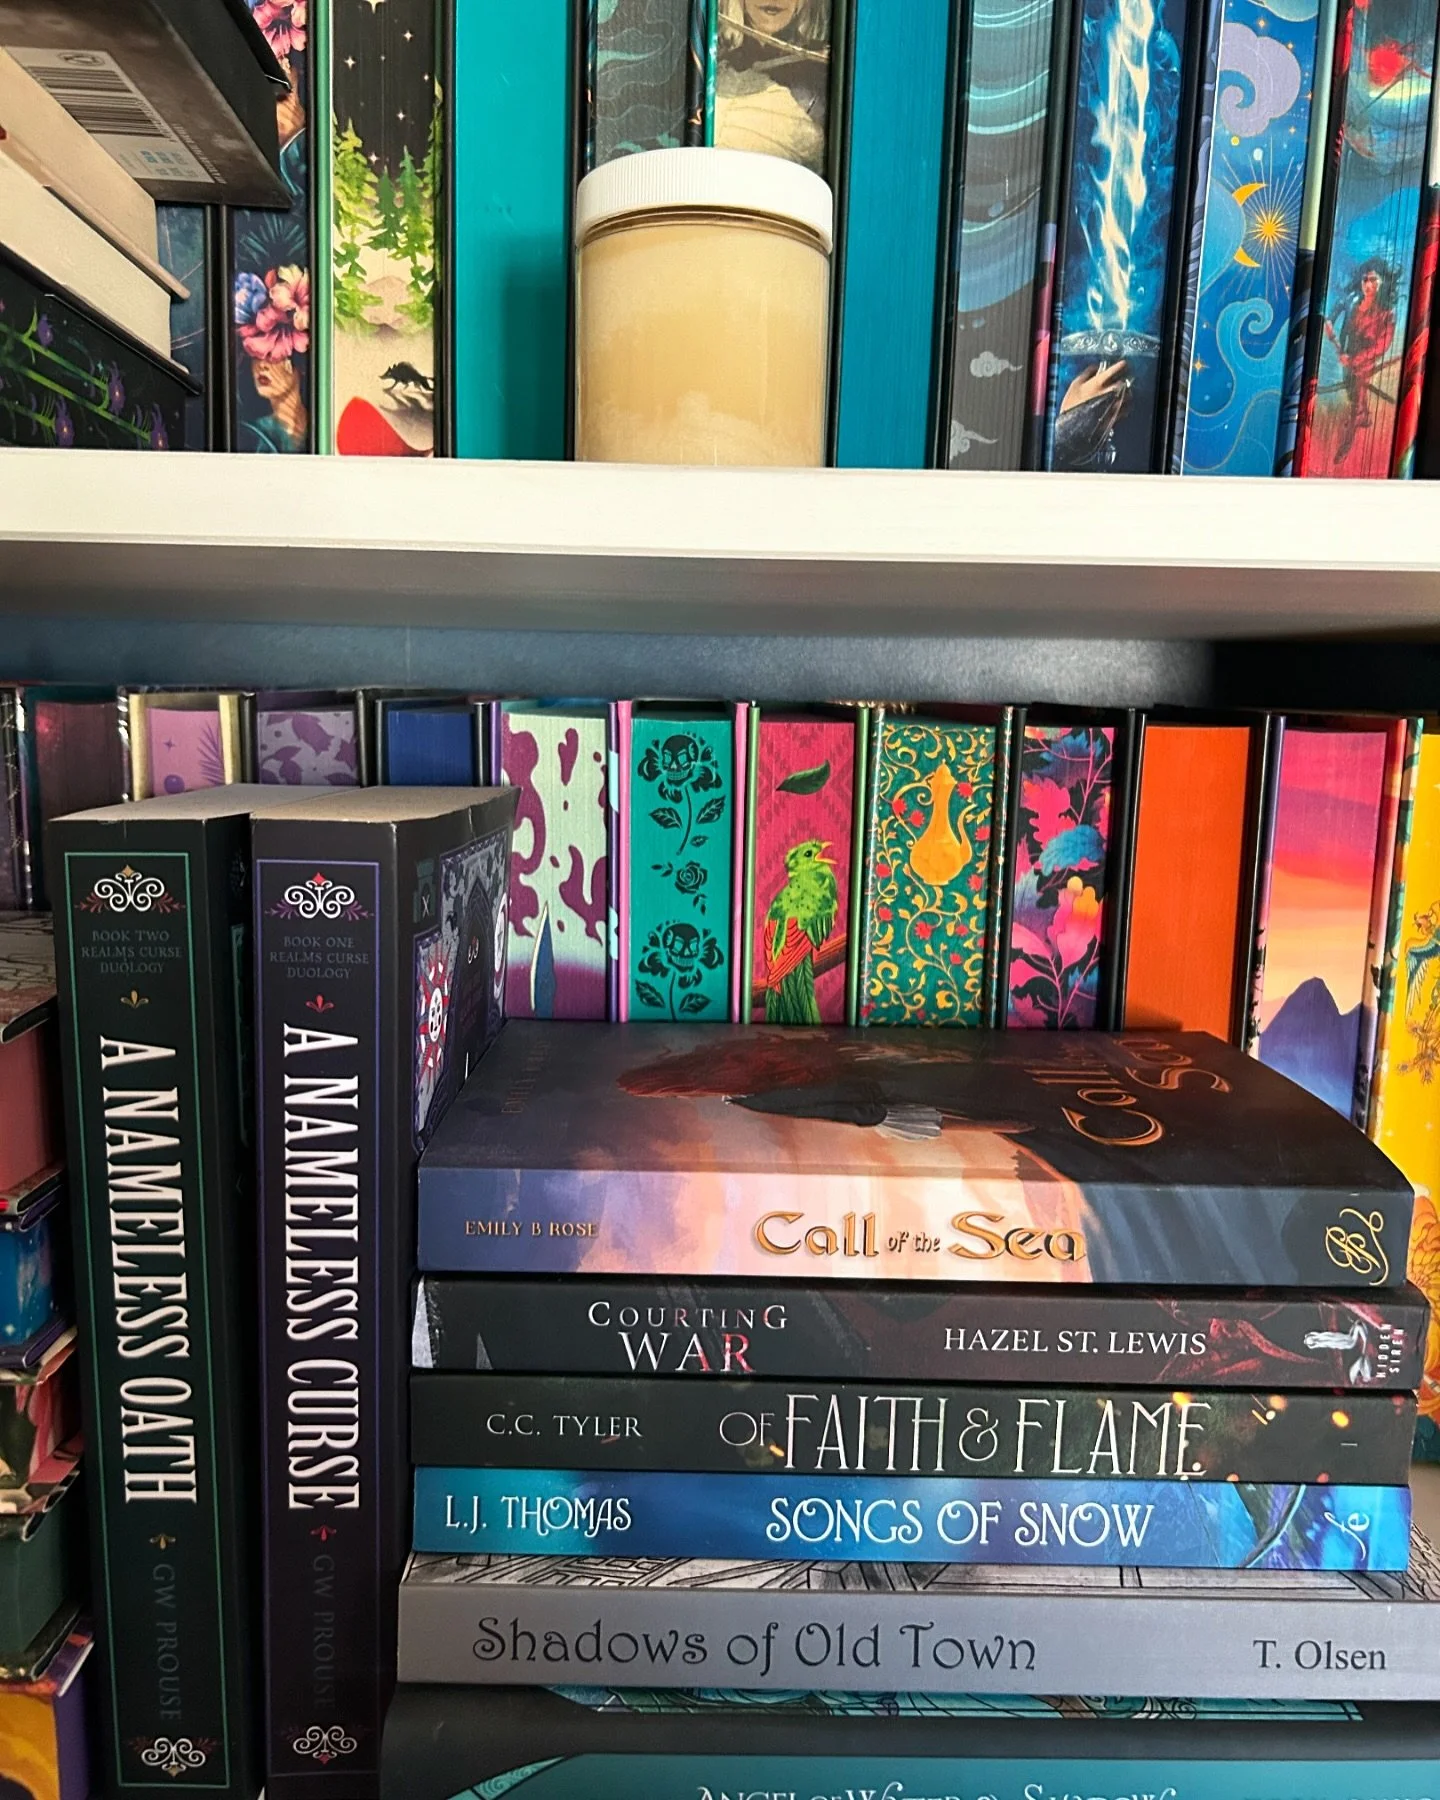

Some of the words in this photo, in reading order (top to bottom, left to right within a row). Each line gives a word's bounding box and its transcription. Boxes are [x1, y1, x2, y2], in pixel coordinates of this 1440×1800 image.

[81, 945, 136, 958] REALMS
[139, 946, 183, 959] CURSE
[92, 929, 131, 942] BOOK
[134, 930, 170, 942] TWO
[283, 935, 321, 948] BOOK
[325, 936, 356, 949] ONE
[100, 961, 166, 974] DUOLOGY
[269, 951, 323, 963] REALMS
[326, 952, 370, 965] CURSE
[286, 966, 352, 979] DUOLOGY
[99, 1034, 177, 1071] A
[282, 1021, 359, 1058] A
[102, 1086, 191, 1360] NAMELESS
[283, 1073, 360, 1342] NAMELESS
[464, 1219, 524, 1237] EMILY
[530, 1221, 542, 1237] B
[549, 1221, 599, 1238] ROSE
[754, 1210, 879, 1258] Call
[887, 1229, 910, 1253] of
[912, 1230, 942, 1253] the
[947, 1210, 1087, 1262] Sea
[587, 1300, 790, 1330] COURTING
[617, 1331, 757, 1374] WAR
[943, 1327, 1050, 1354] HAZEL
[1056, 1329, 1099, 1354] ST.
[1107, 1331, 1208, 1357] LEWIS
[1375, 1322, 1392, 1379] HIDDEN
[1388, 1328, 1405, 1374] SIREN
[119, 1376, 198, 1505] OATH
[286, 1357, 361, 1511] CURSE
[486, 1413, 541, 1437] C.C.
[553, 1414, 644, 1438] TYLER
[719, 1411, 776, 1447] OF
[784, 1394, 946, 1472] FAITH
[958, 1407, 999, 1462] &
[1013, 1397, 1213, 1477] FLAME
[445, 1495, 487, 1530] L.J.
[501, 1495, 633, 1538] THOMAS
[765, 1497, 924, 1544] SONGS
[936, 1500, 1002, 1546] OF
[1014, 1501, 1155, 1549] SNOW
[153, 1562, 176, 1609] GW
[313, 1553, 336, 1599] GW
[313, 1611, 336, 1710] PROUSE
[472, 1616, 708, 1666] Shadows
[726, 1621, 779, 1678] of
[795, 1622, 881, 1669] Old
[899, 1622, 1036, 1672] Town
[1252, 1638, 1282, 1670] T.
[1294, 1639, 1387, 1671] Olsen
[156, 1621, 182, 1721] PROUSE
